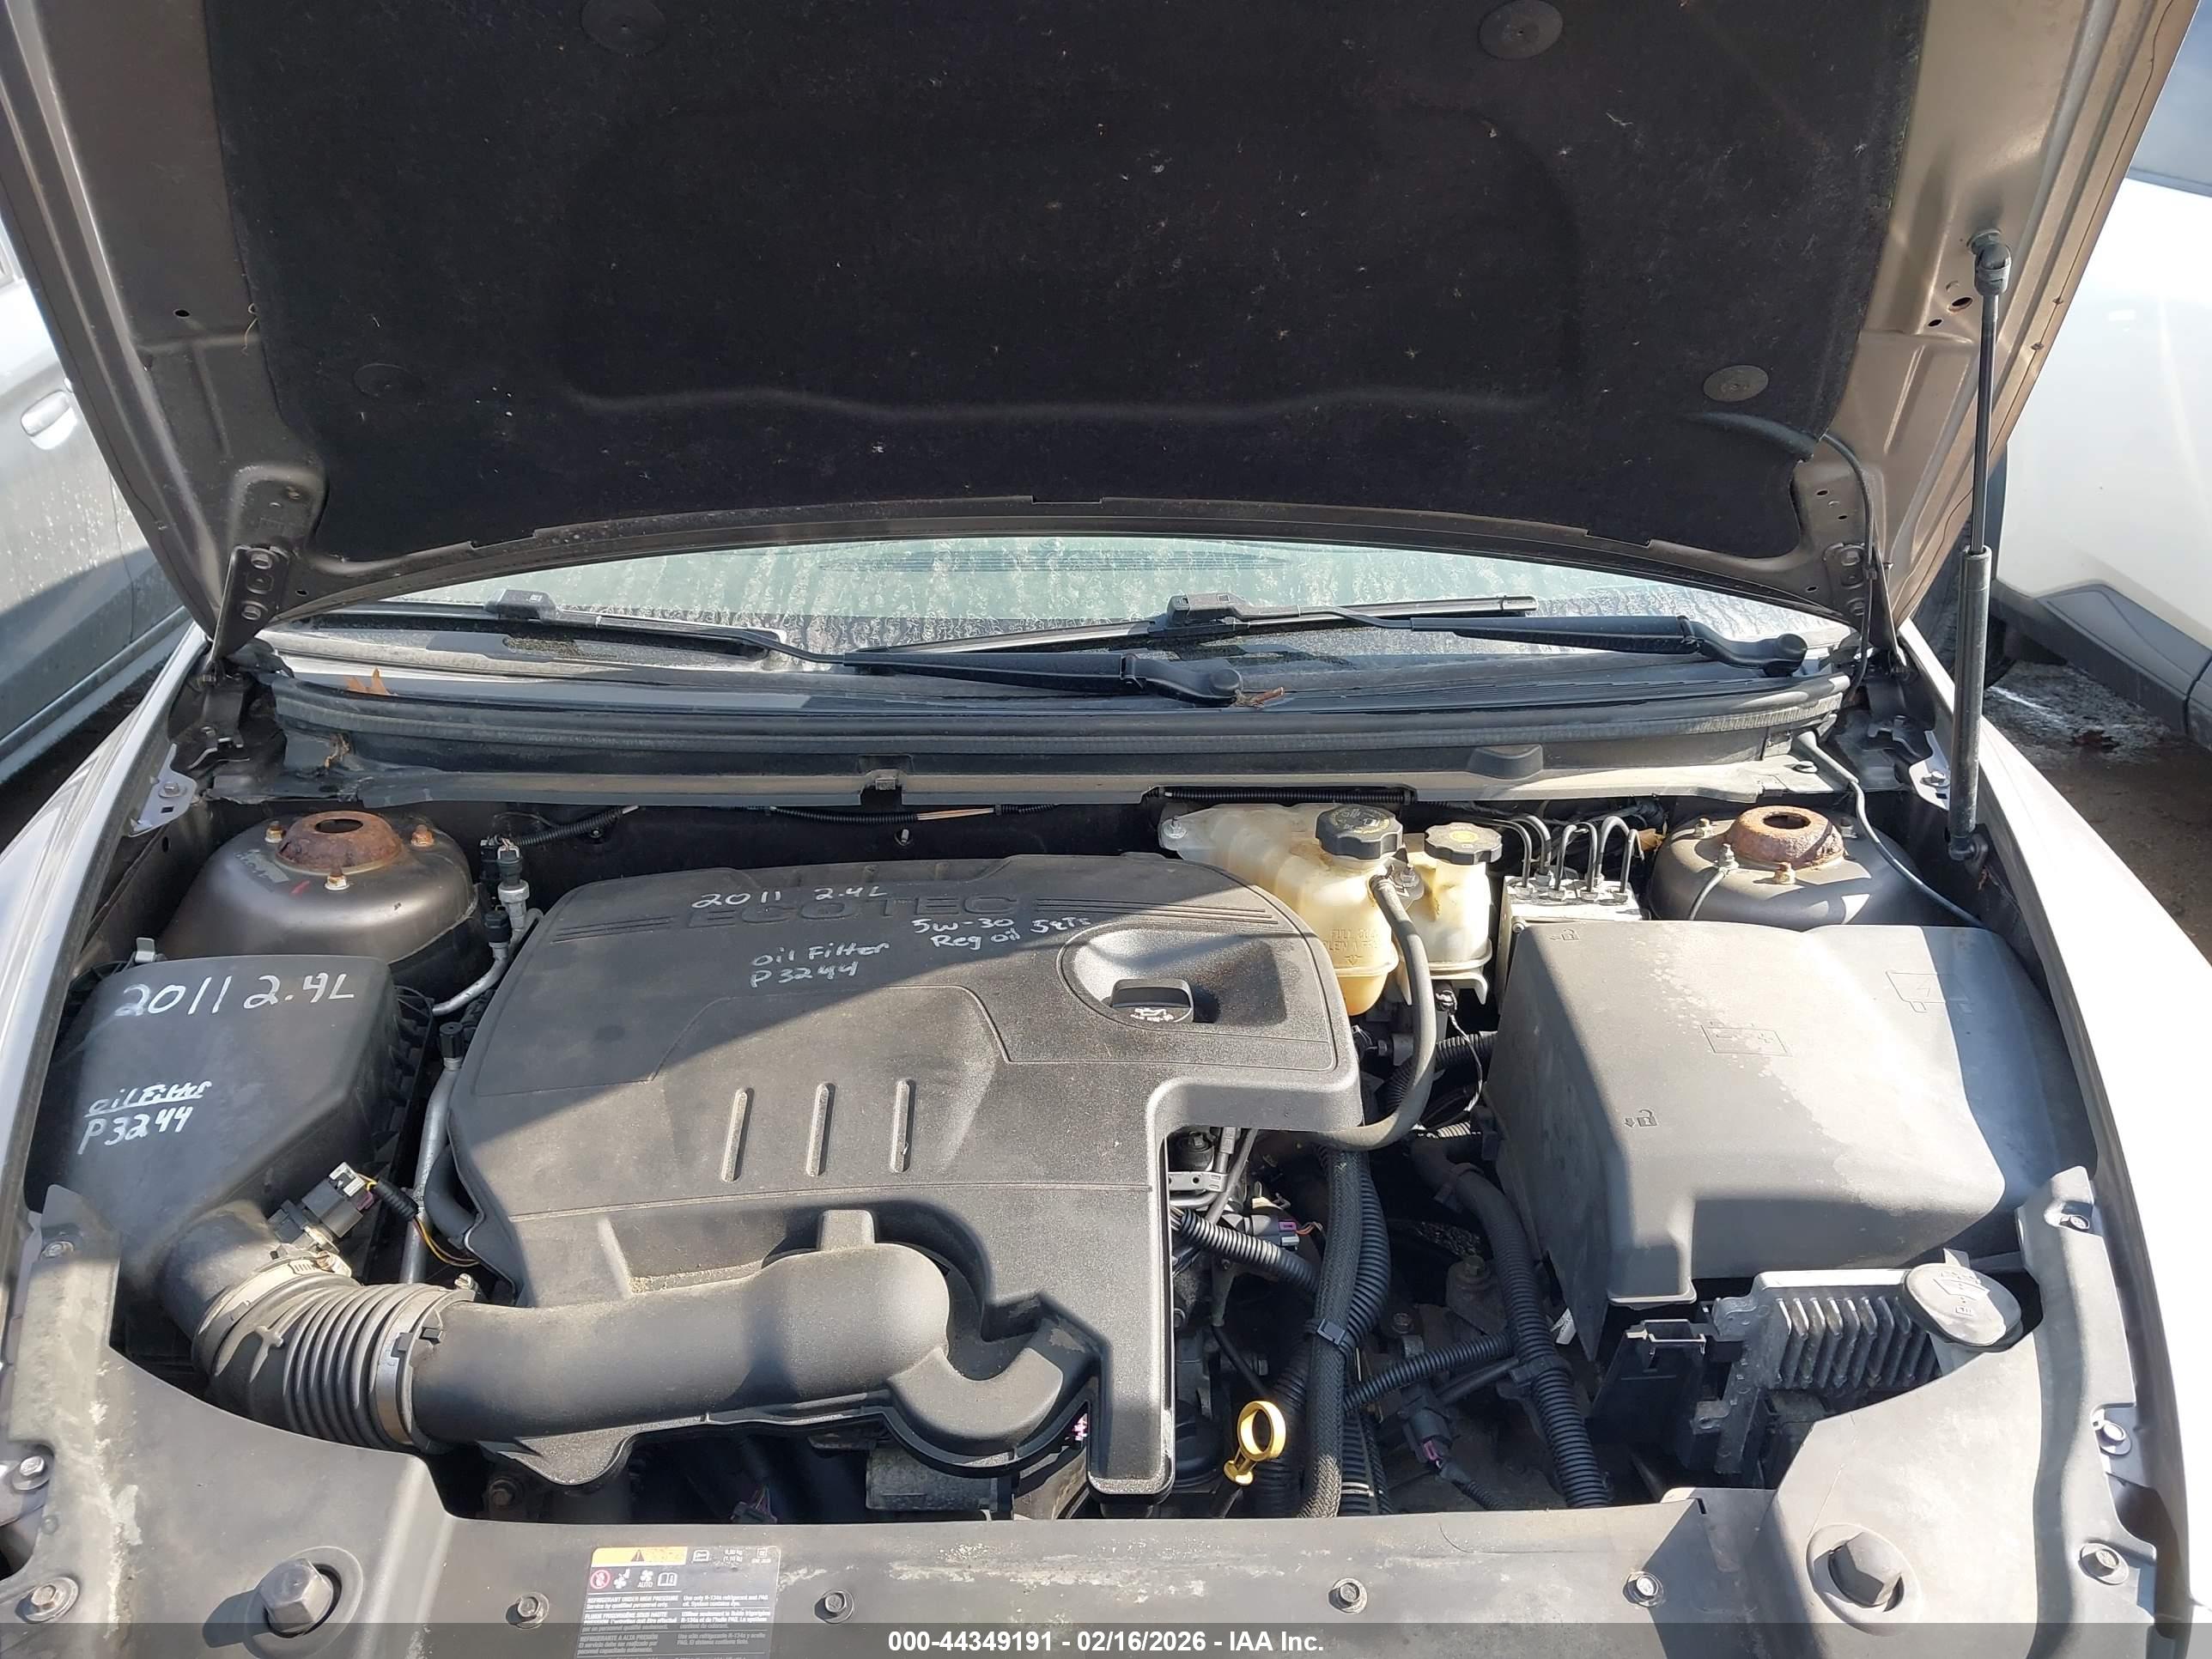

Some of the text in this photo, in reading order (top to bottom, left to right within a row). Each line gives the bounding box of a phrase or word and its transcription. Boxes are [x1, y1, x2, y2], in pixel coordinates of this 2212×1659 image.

[688, 895, 1018, 928] ECOTEC
[691, 886, 888, 908] 2011 2.4L
[930, 934, 982, 950] Reg
[114, 972, 355, 1017] 2011 2.4L
[77, 1106, 193, 1154] P3244
